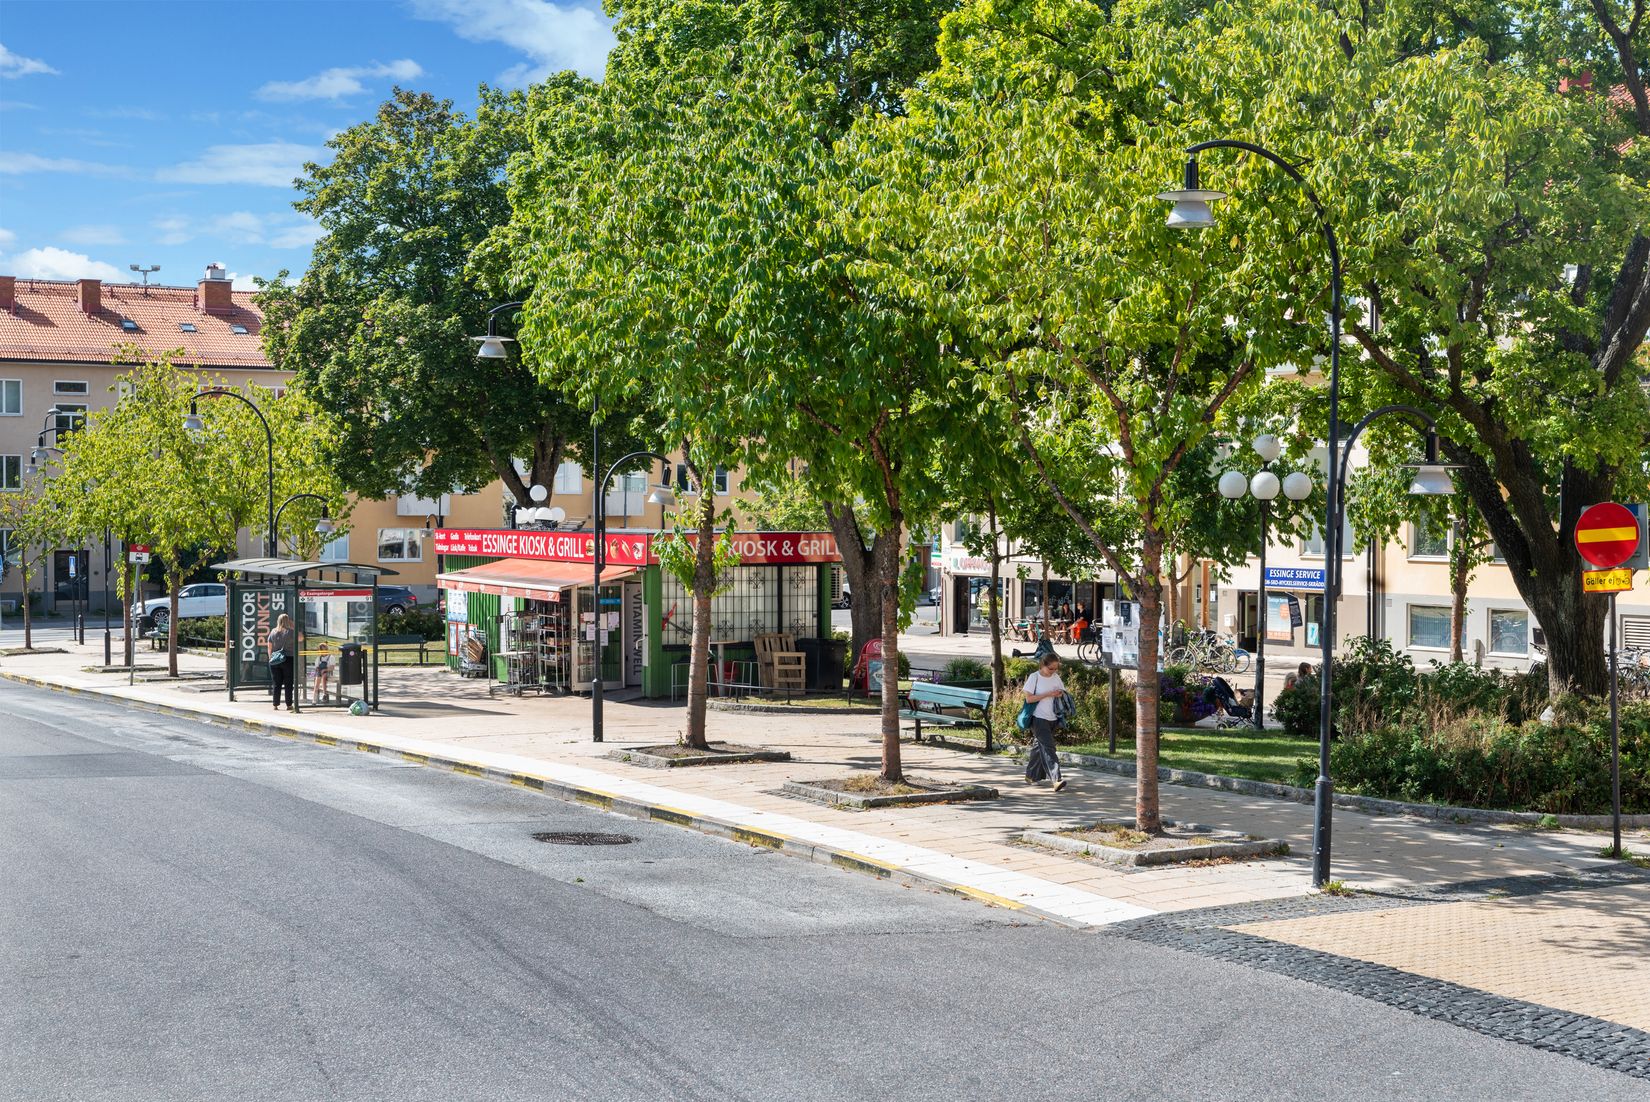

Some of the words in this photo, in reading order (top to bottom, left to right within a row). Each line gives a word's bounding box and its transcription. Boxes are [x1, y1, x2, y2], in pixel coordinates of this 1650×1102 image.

[482, 534, 517, 554] ESSINGE
[519, 537, 546, 557] KIOSK
[548, 539, 555, 557] &
[556, 539, 584, 558] GRILL
[728, 540, 778, 557] KIOSK
[781, 540, 793, 556] &
[1269, 569, 1294, 578] ESSINGE
[1295, 570, 1321, 579] SERVICE
[1585, 577, 1606, 585] Gäller
[1608, 577, 1615, 585] ej
[272, 593, 285, 611] SE
[242, 592, 256, 662] DOKTOR
[257, 592, 270, 647] PUNKT
[633, 593, 643, 642] VITAMIN
